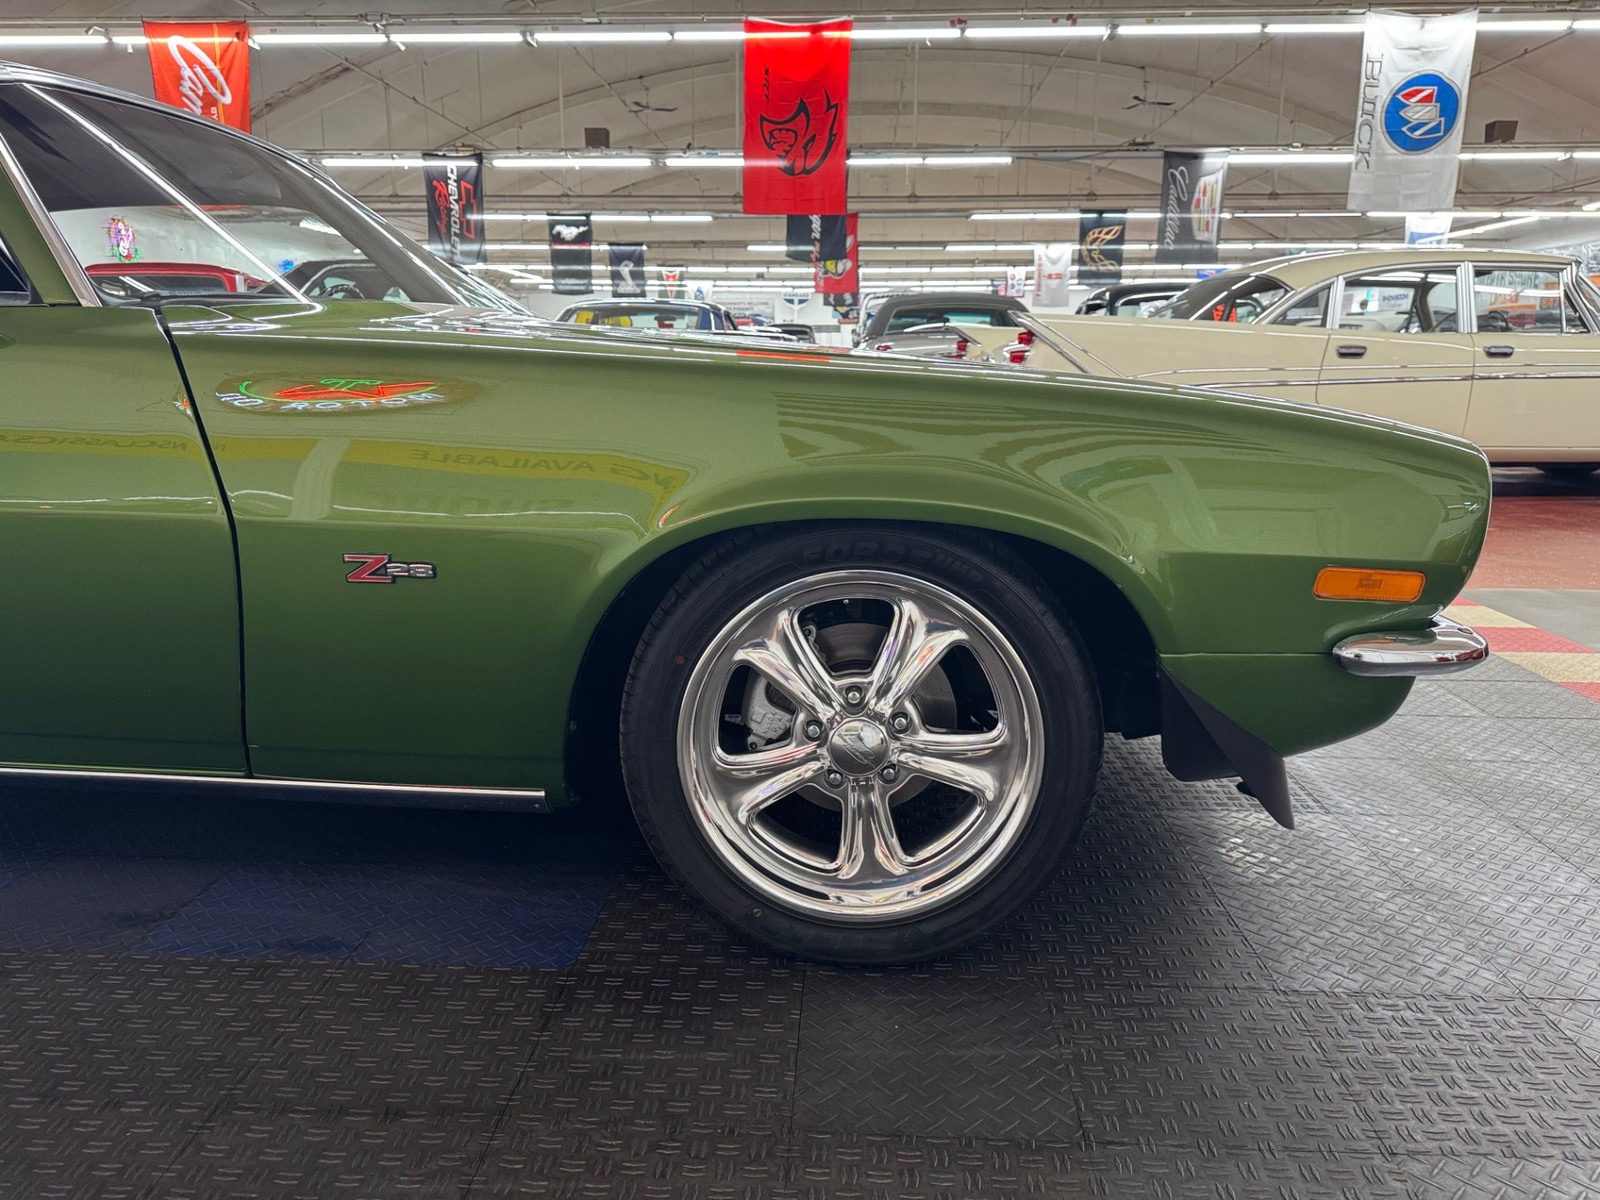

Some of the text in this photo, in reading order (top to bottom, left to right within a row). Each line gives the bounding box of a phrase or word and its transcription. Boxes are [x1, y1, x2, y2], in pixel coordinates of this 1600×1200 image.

[762, 64, 770, 105] SRT
[1355, 53, 1384, 171] BUICK
[432, 180, 449, 234] Racing
[447, 165, 461, 256] CHEVROLET
[1164, 165, 1189, 250] Cadillac
[342, 552, 437, 583] Z28
